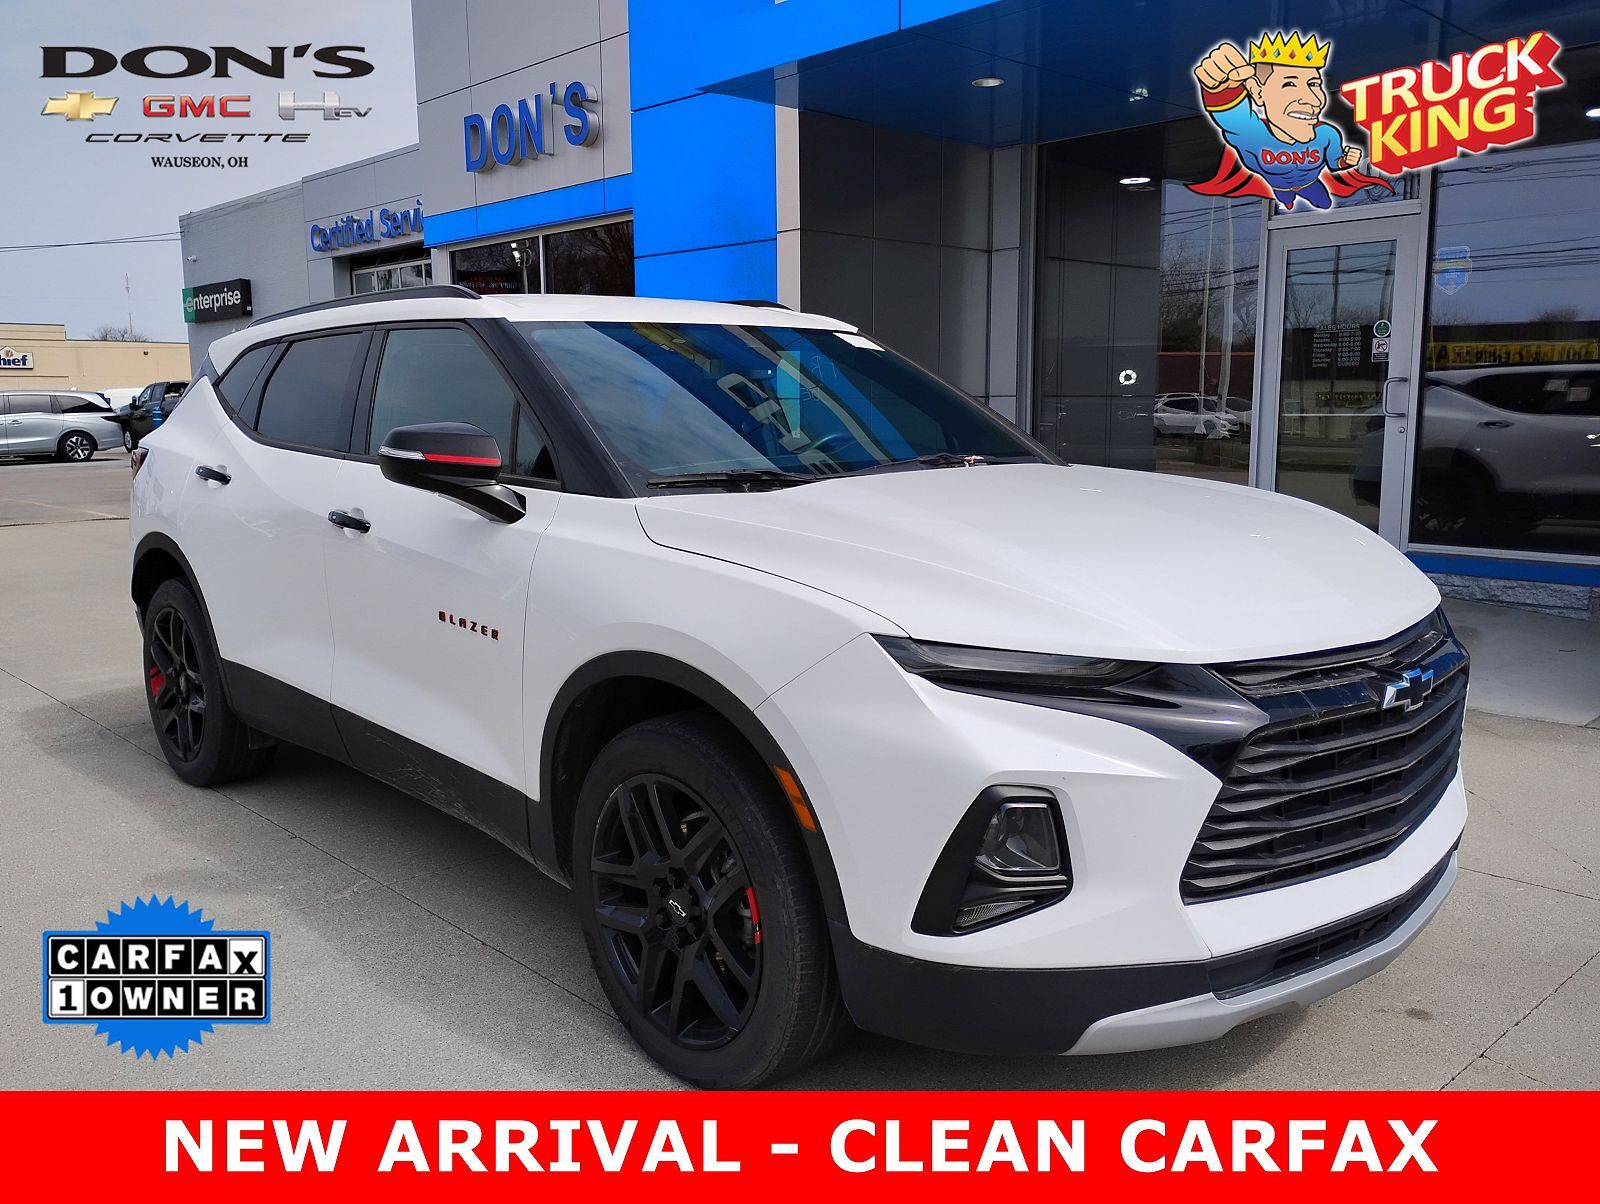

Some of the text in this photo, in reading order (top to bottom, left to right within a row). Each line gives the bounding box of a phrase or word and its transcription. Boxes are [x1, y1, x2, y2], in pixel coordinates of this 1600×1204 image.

[463, 80, 597, 173] DON'S
[310, 199, 424, 252] Certified Servi
[184, 287, 241, 313] enterprise
[438, 610, 499, 641] BLAZER
